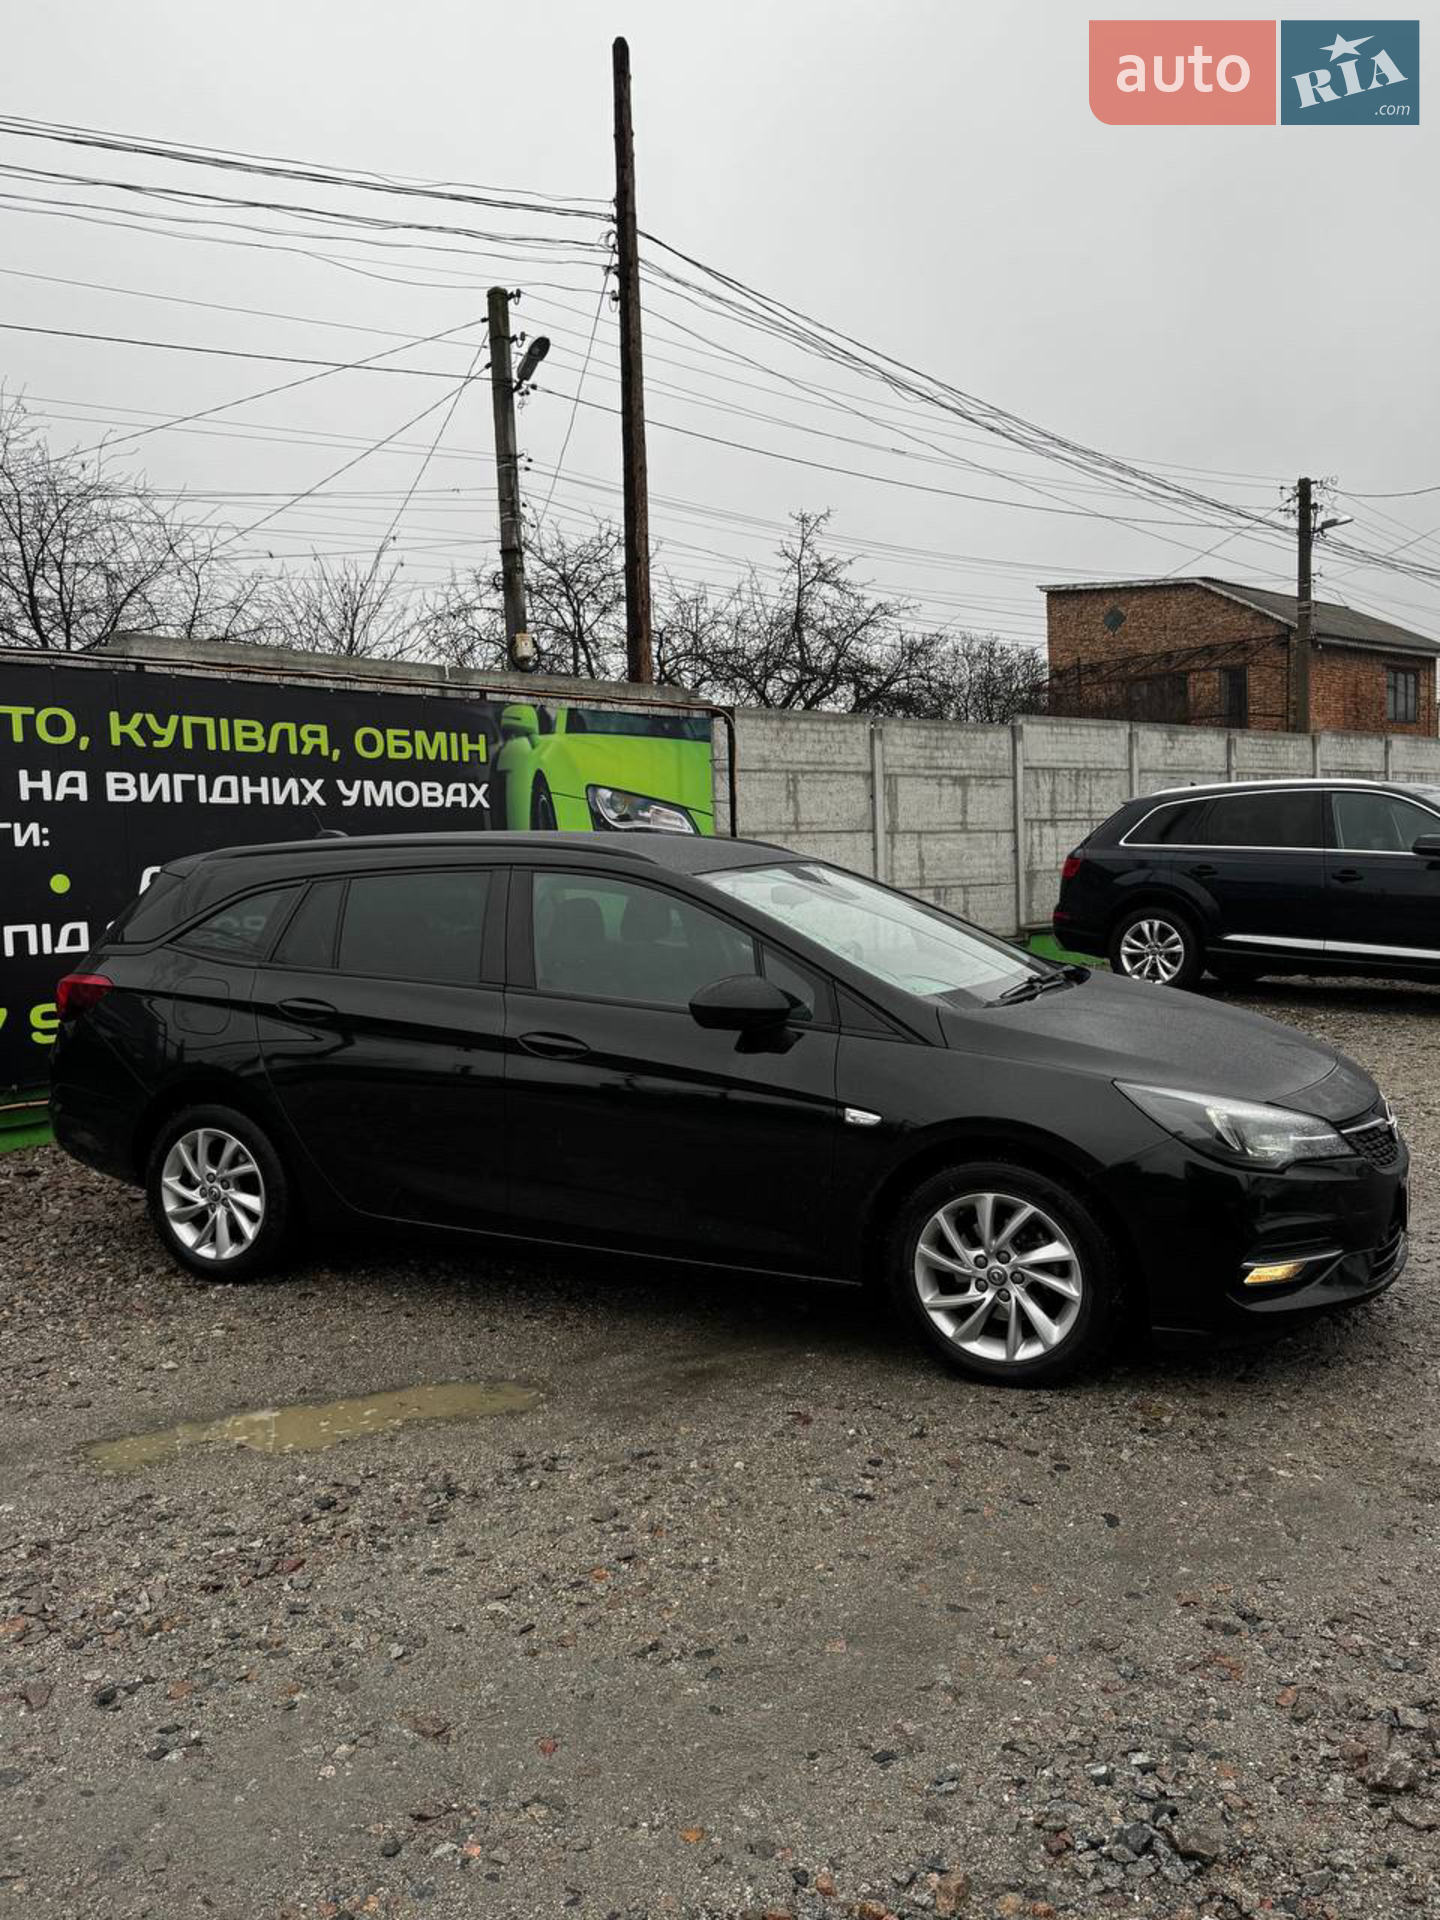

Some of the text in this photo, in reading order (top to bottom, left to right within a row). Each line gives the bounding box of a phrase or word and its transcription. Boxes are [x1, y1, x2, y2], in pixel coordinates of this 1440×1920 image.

[108, 710, 341, 762] КУПІВЛЯ,
[353, 726, 488, 763] ОБМІН
[18, 769, 491, 809] НА ВИГІДНИХ УМОВАХ
[3, 921, 90, 957] ПІД
